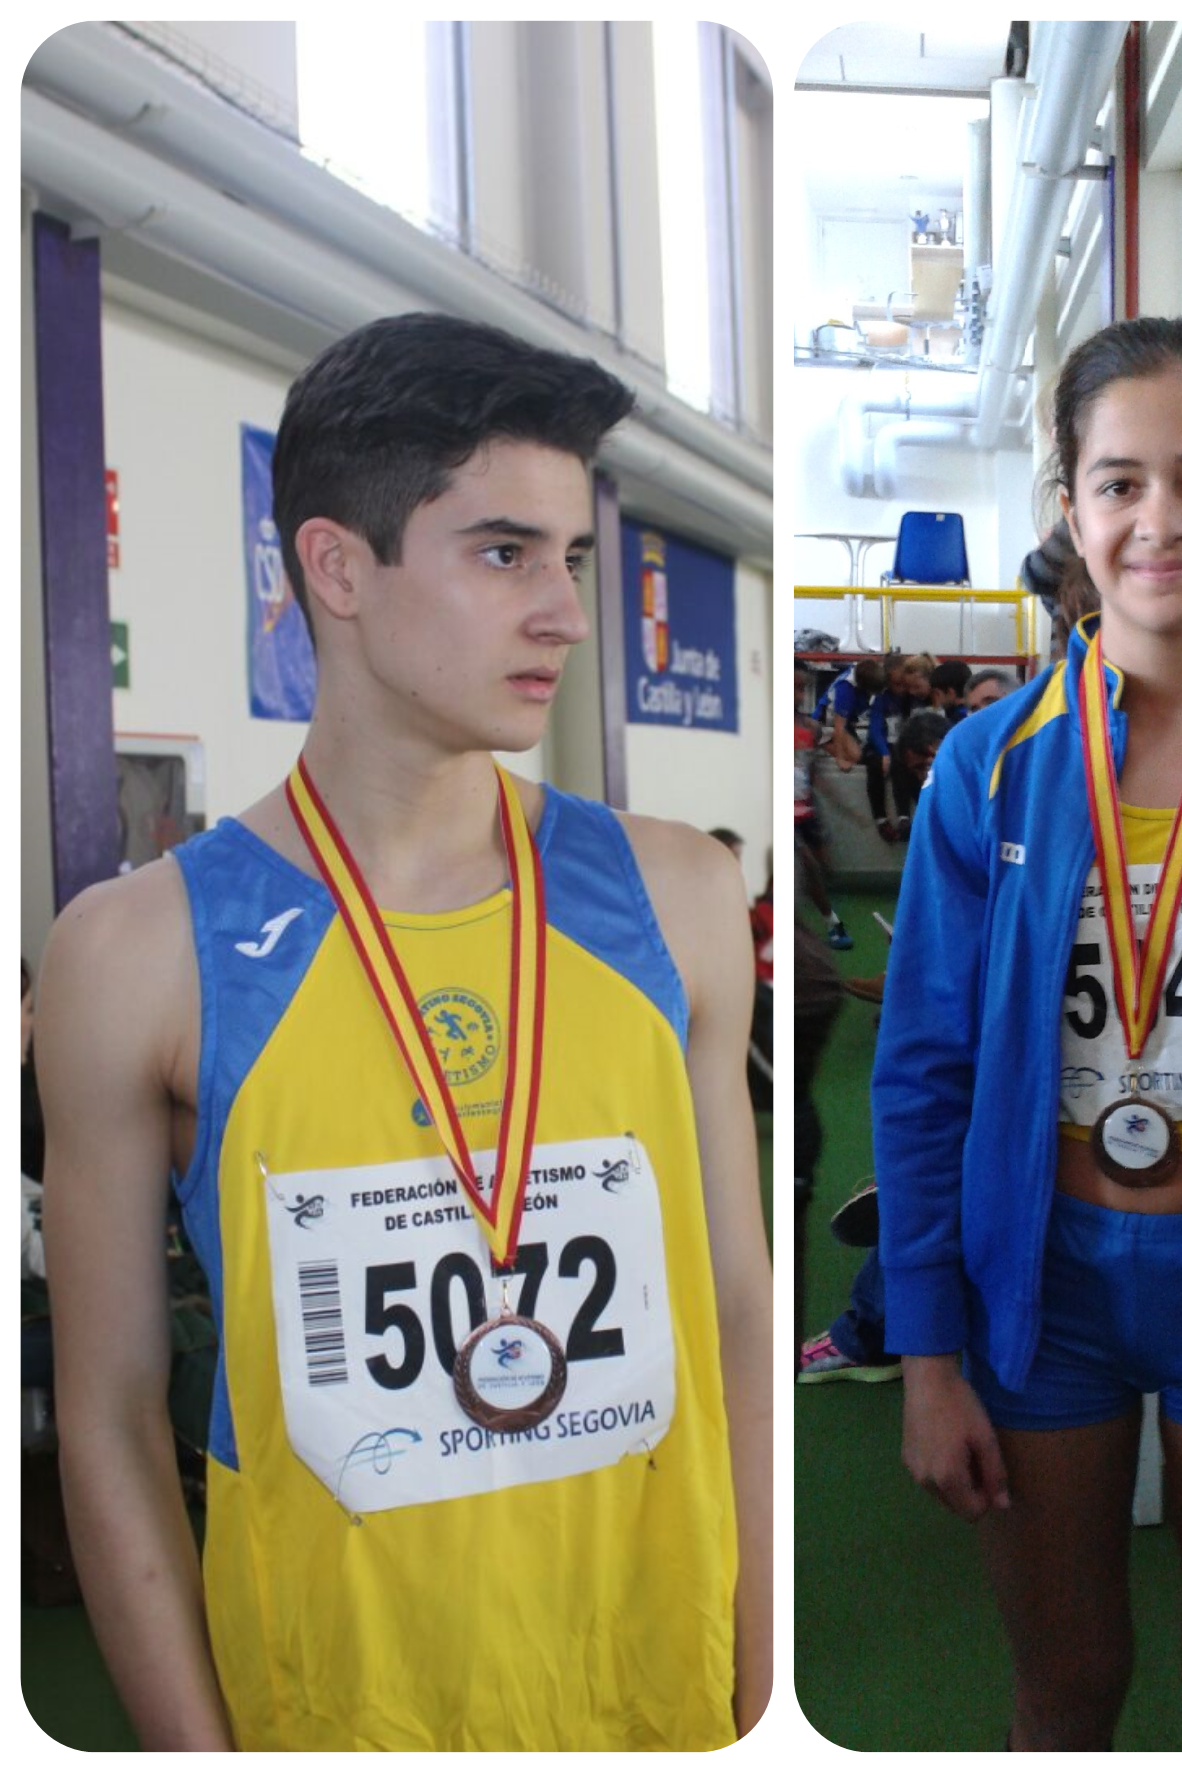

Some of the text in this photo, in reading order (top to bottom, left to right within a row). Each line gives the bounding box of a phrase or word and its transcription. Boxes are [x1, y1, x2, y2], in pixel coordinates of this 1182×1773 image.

[705, 648, 721, 682] de
[638, 676, 682, 714] Castilla
[350, 1176, 458, 1208] FEDERACIÓN
[489, 1164, 586, 1190] TISMO
[385, 1192, 558, 1232] DE CASTIL EÓN
[365, 1235, 626, 1391] 5072
[557, 1399, 656, 1440] SEGOVIA
